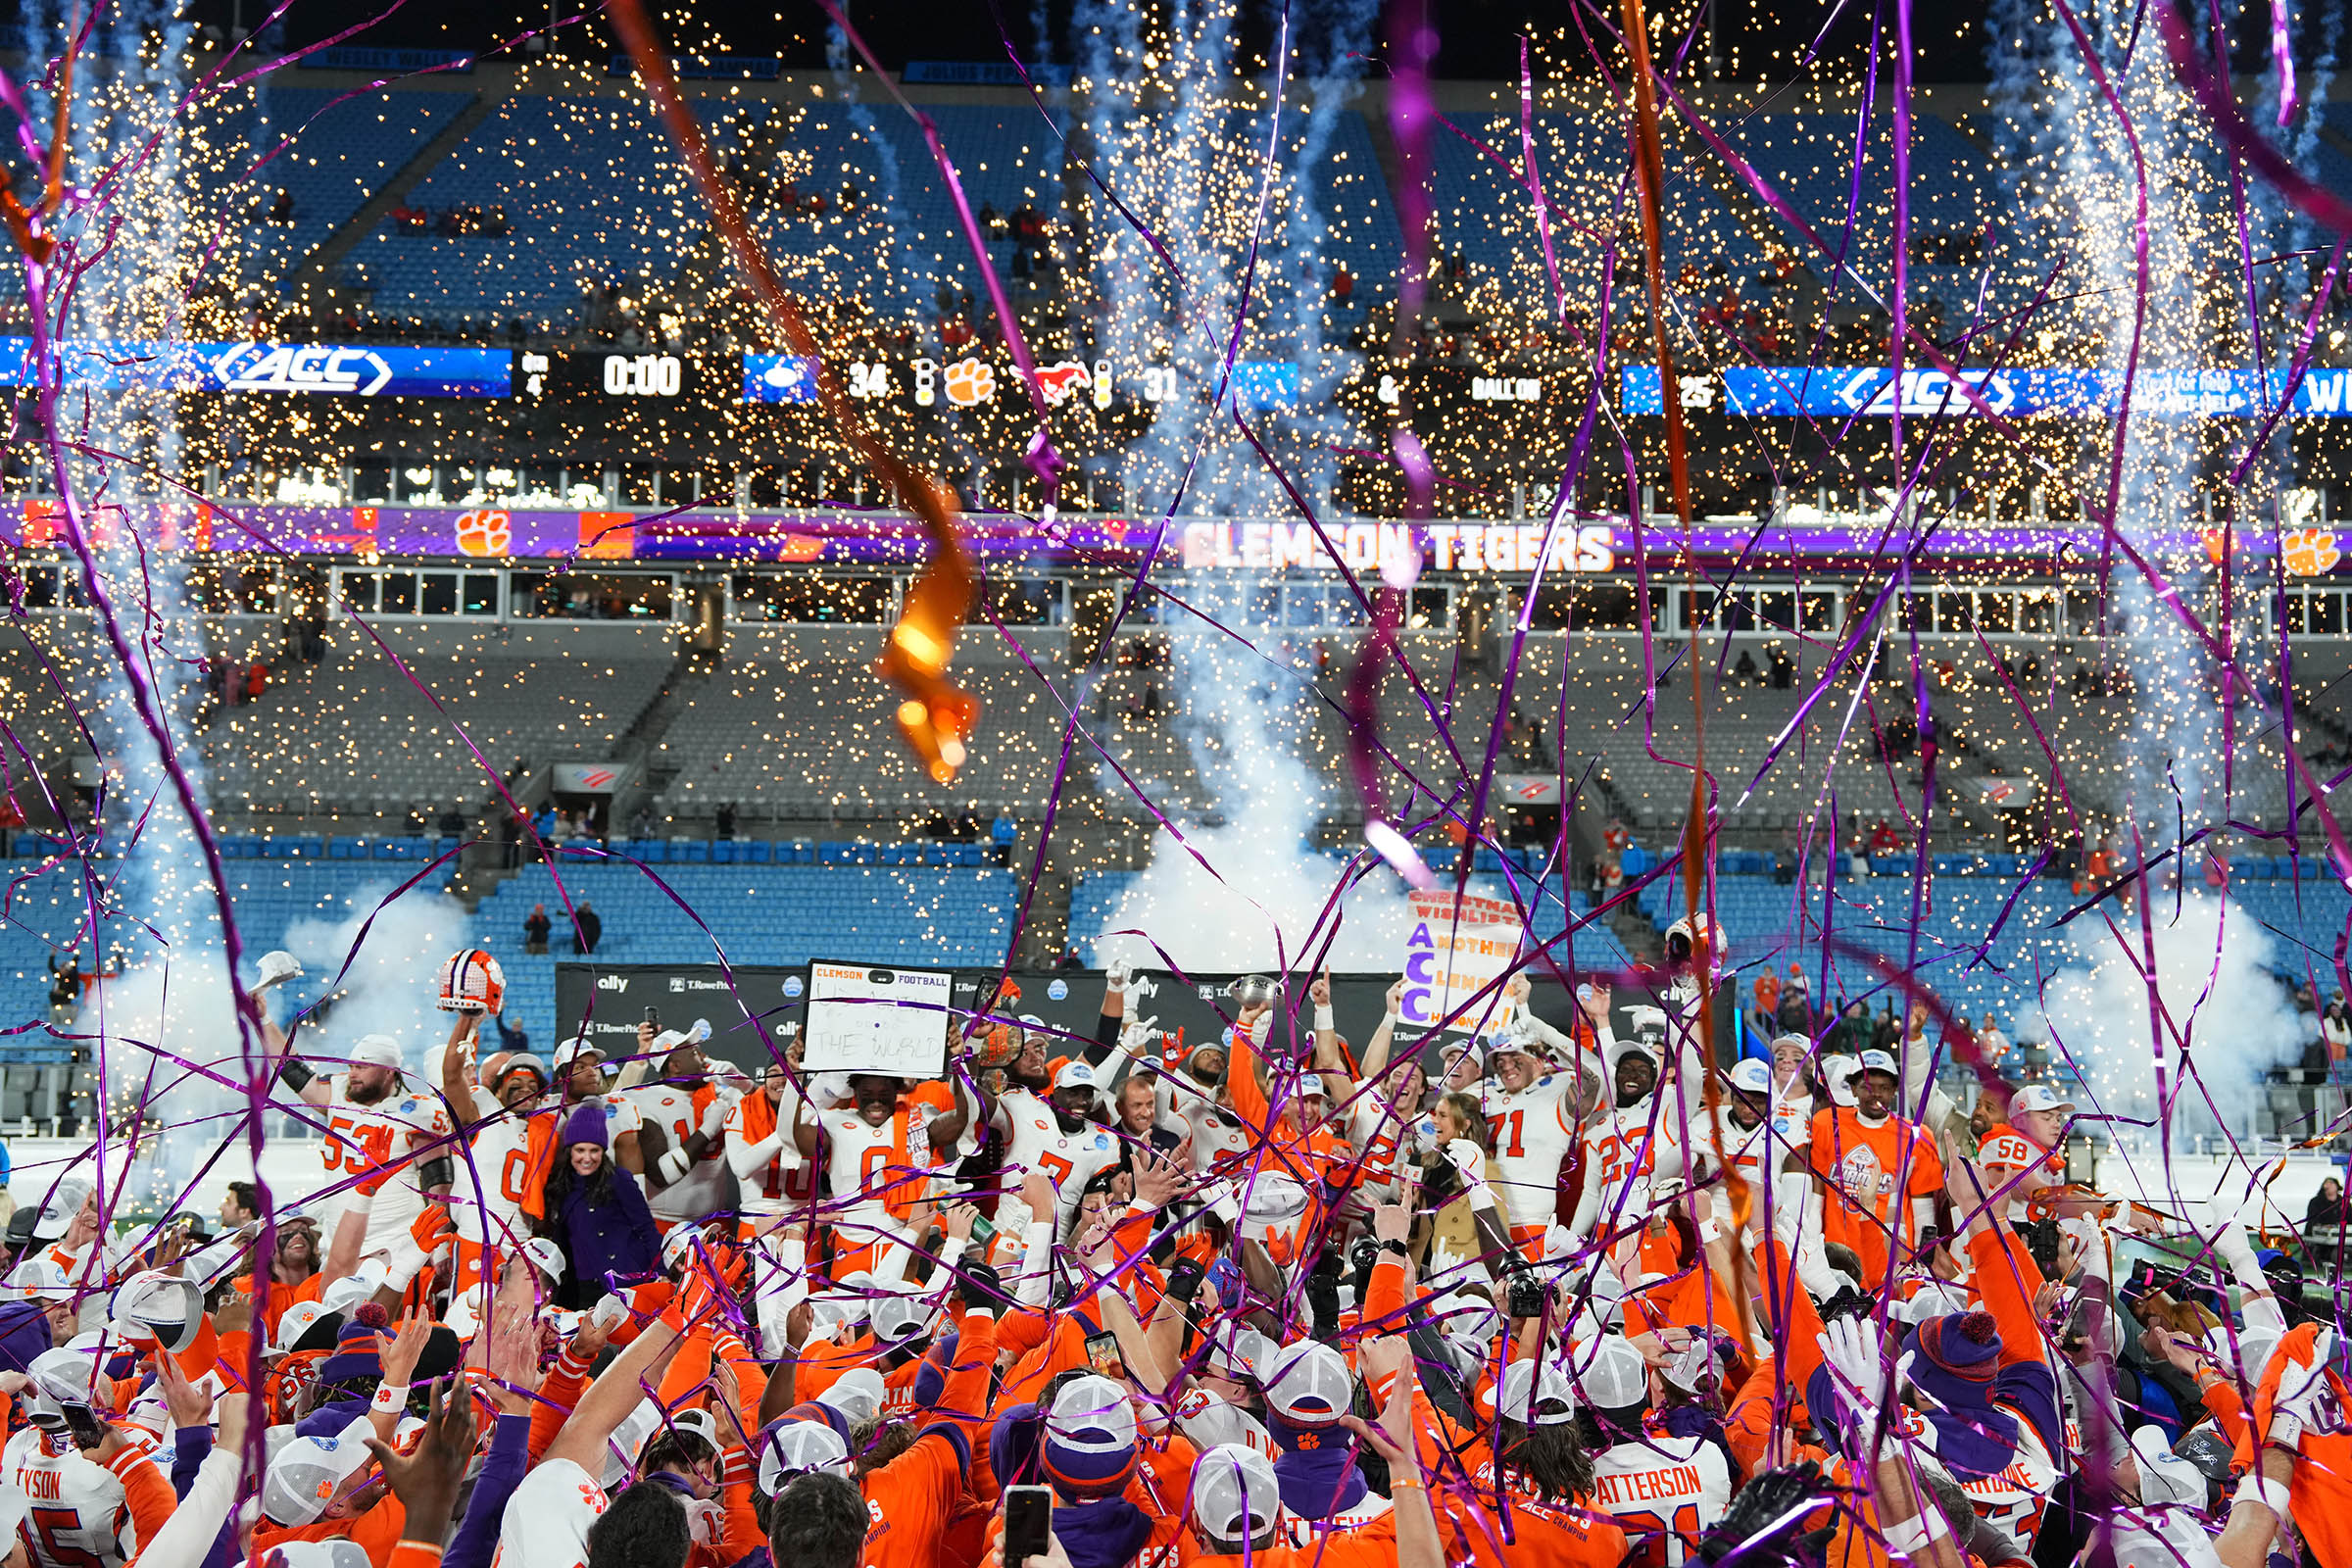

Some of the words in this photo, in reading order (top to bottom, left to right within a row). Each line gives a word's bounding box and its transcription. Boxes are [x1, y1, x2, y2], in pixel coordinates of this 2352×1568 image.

[233, 347, 370, 390] ACC
[605, 355, 681, 396] 0:00
[849, 363, 889, 399] 34
[1144, 368, 1178, 401] 31
[1472, 377, 1514, 400] BALL
[1680, 375, 1712, 408] 25
[1183, 521, 1412, 570] CLEMSON
[1427, 523, 1615, 572] TIGERS
[1409, 890, 1528, 915] CHRSTMA
[598, 975, 628, 993] ally
[816, 968, 863, 980] CLEMSON
[899, 975, 947, 987] FOOTBALL
[319, 1116, 370, 1174] 53
[1485, 1109, 1526, 1158] 71
[1998, 1138, 2029, 1162] 58
[1039, 1150, 1075, 1189] 7
[1598, 1125, 1657, 1186] 23
[17, 1468, 63, 1500] TYSON
[1595, 1465, 1703, 1506] ATTERSON
[1516, 1500, 1552, 1521] ACC
[1552, 1515, 1589, 1544] CHAMPION
